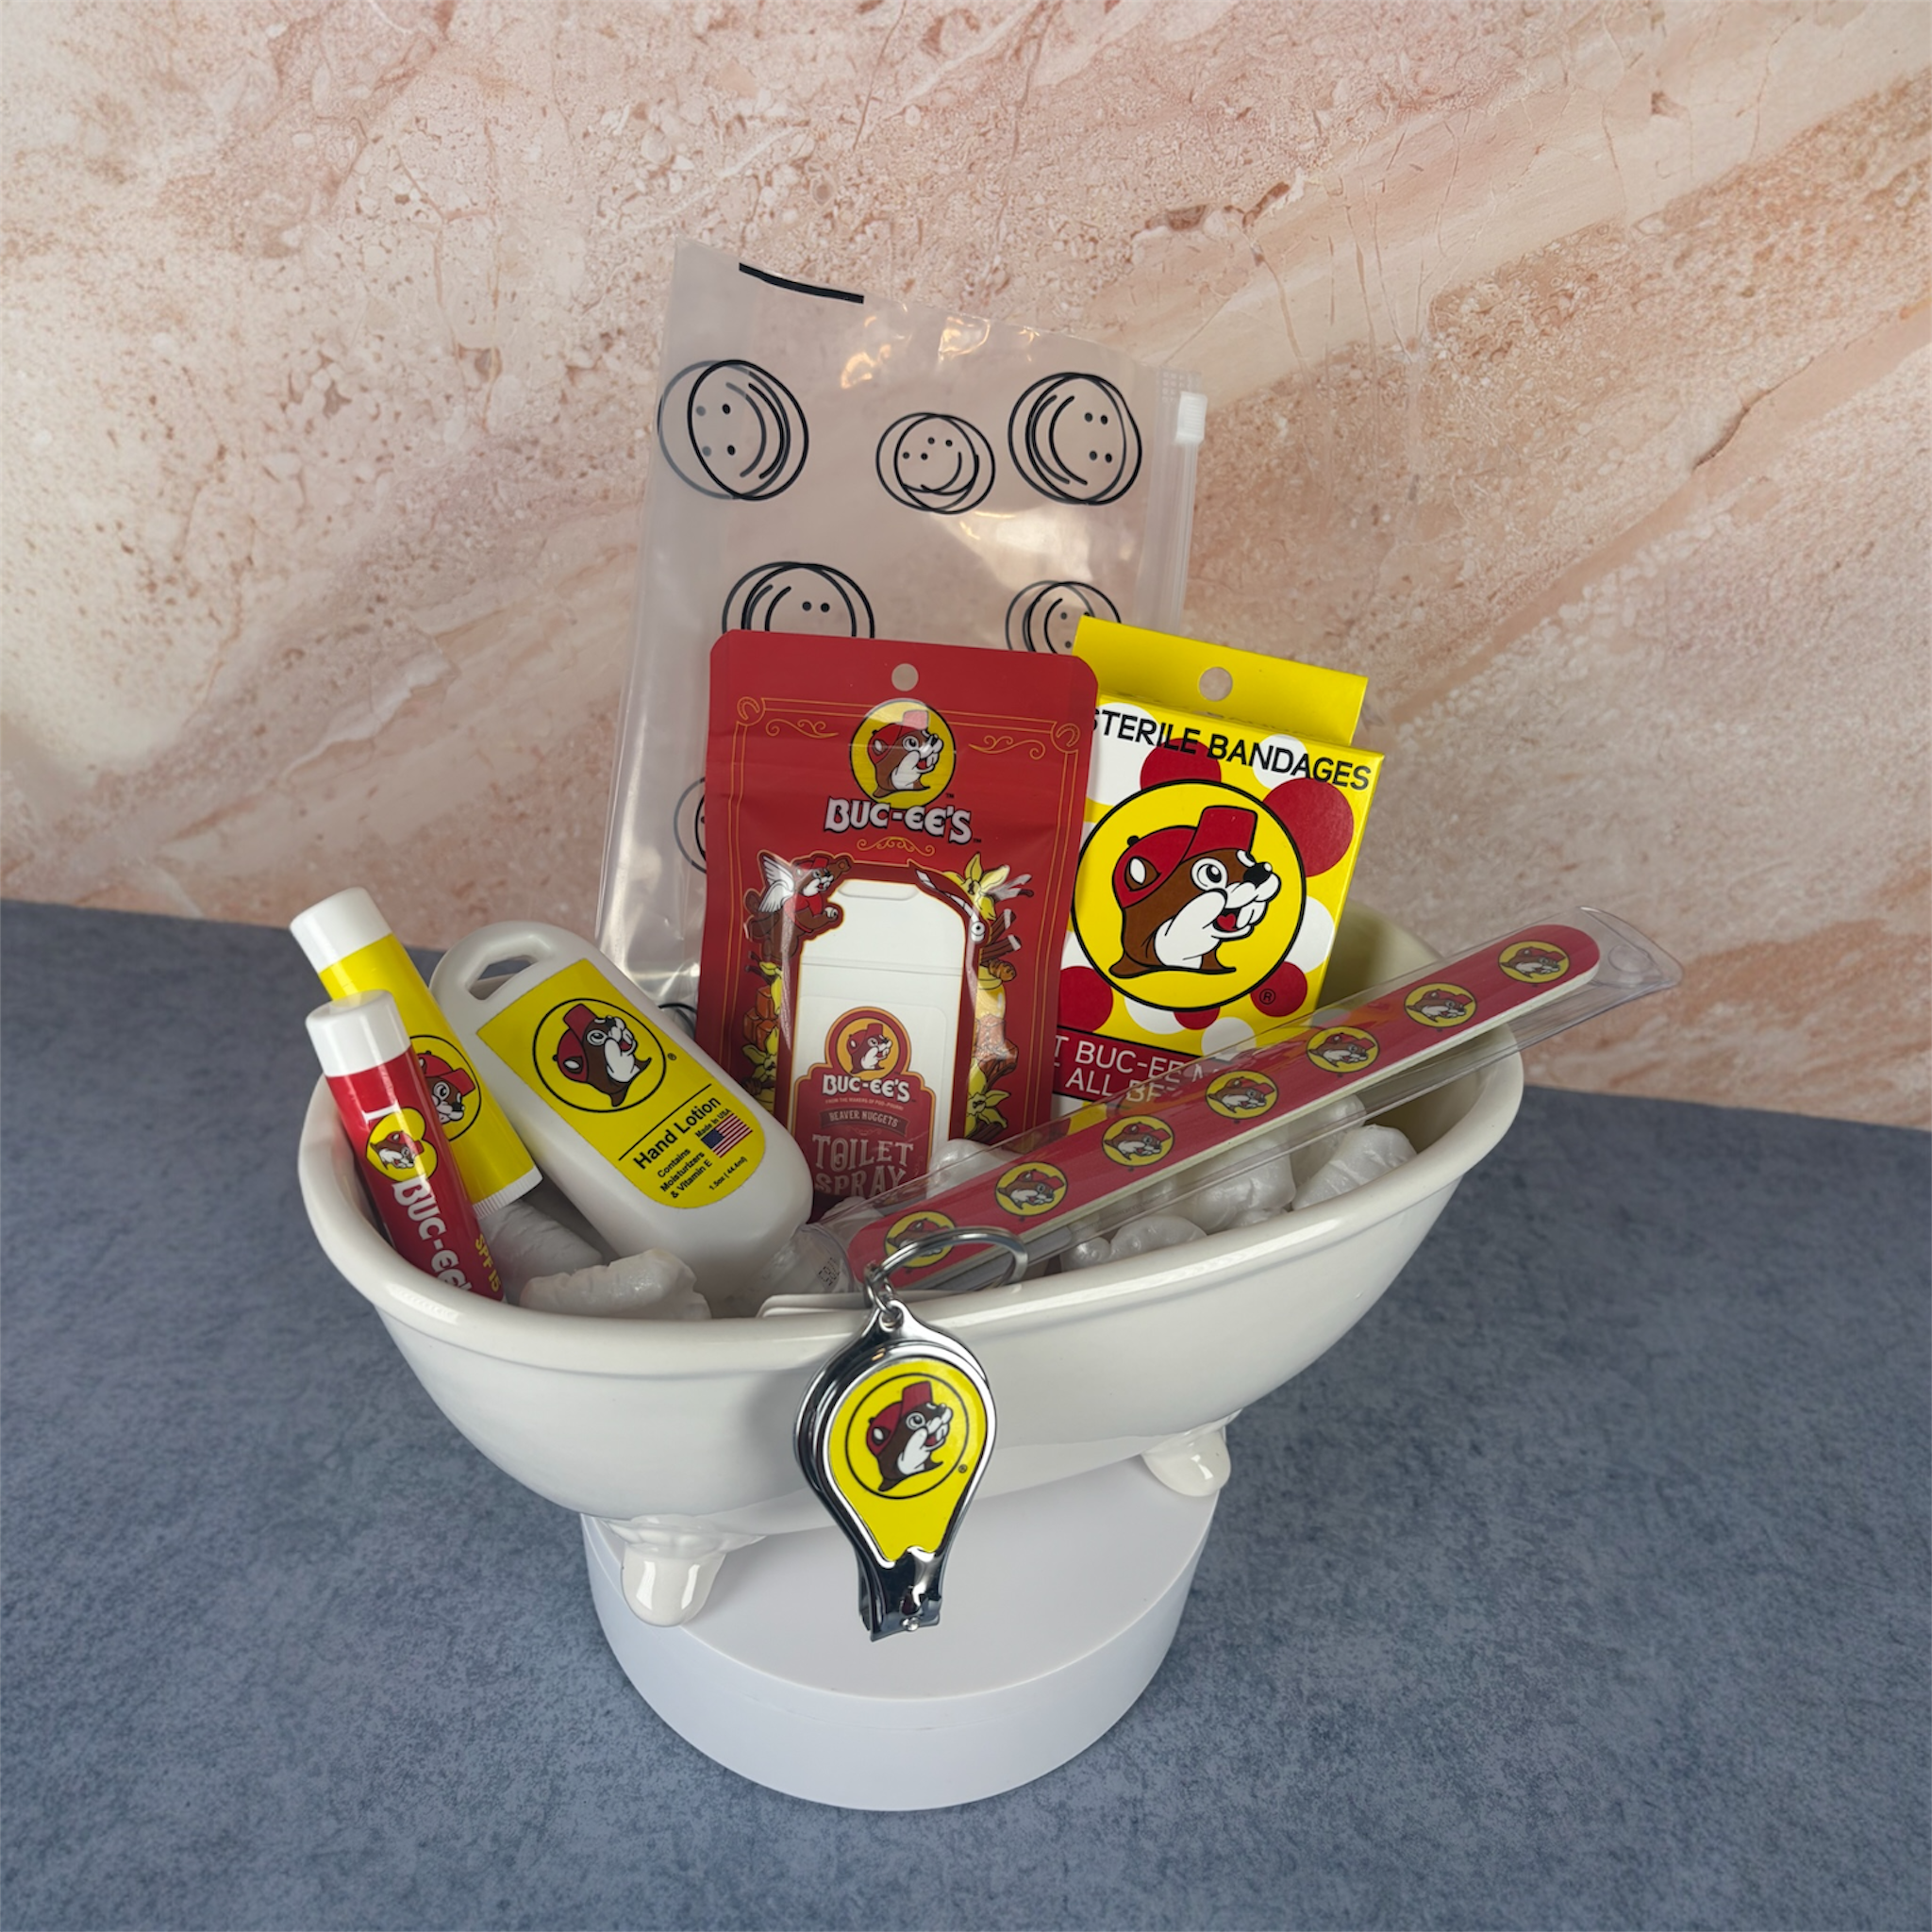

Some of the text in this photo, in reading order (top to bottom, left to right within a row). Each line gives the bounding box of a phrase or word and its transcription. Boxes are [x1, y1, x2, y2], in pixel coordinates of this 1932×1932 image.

[1207, 733, 1373, 791] BANDAGES
[824, 796, 973, 845] BUC-EE'S
[822, 1074, 911, 1103] BUC-EE'S
[1065, 1067, 1113, 1097] ALL
[633, 1097, 722, 1170] Hand Lotion
[694, 1123, 712, 1138] Made
[717, 1108, 732, 1119] USA
[828, 1109, 899, 1128] BEAVER NUGGETS
[657, 1148, 691, 1178] Contains
[659, 1152, 706, 1192] Moisturizers
[811, 1134, 914, 1173] TOILET
[670, 1159, 713, 1199] & Vitamin E
[708, 1175, 725, 1191] 1.5oz
[814, 1165, 907, 1199] SPRAY
[391, 1173, 472, 1291] BUC-EE'
[475, 1233, 502, 1292] SPF 15
